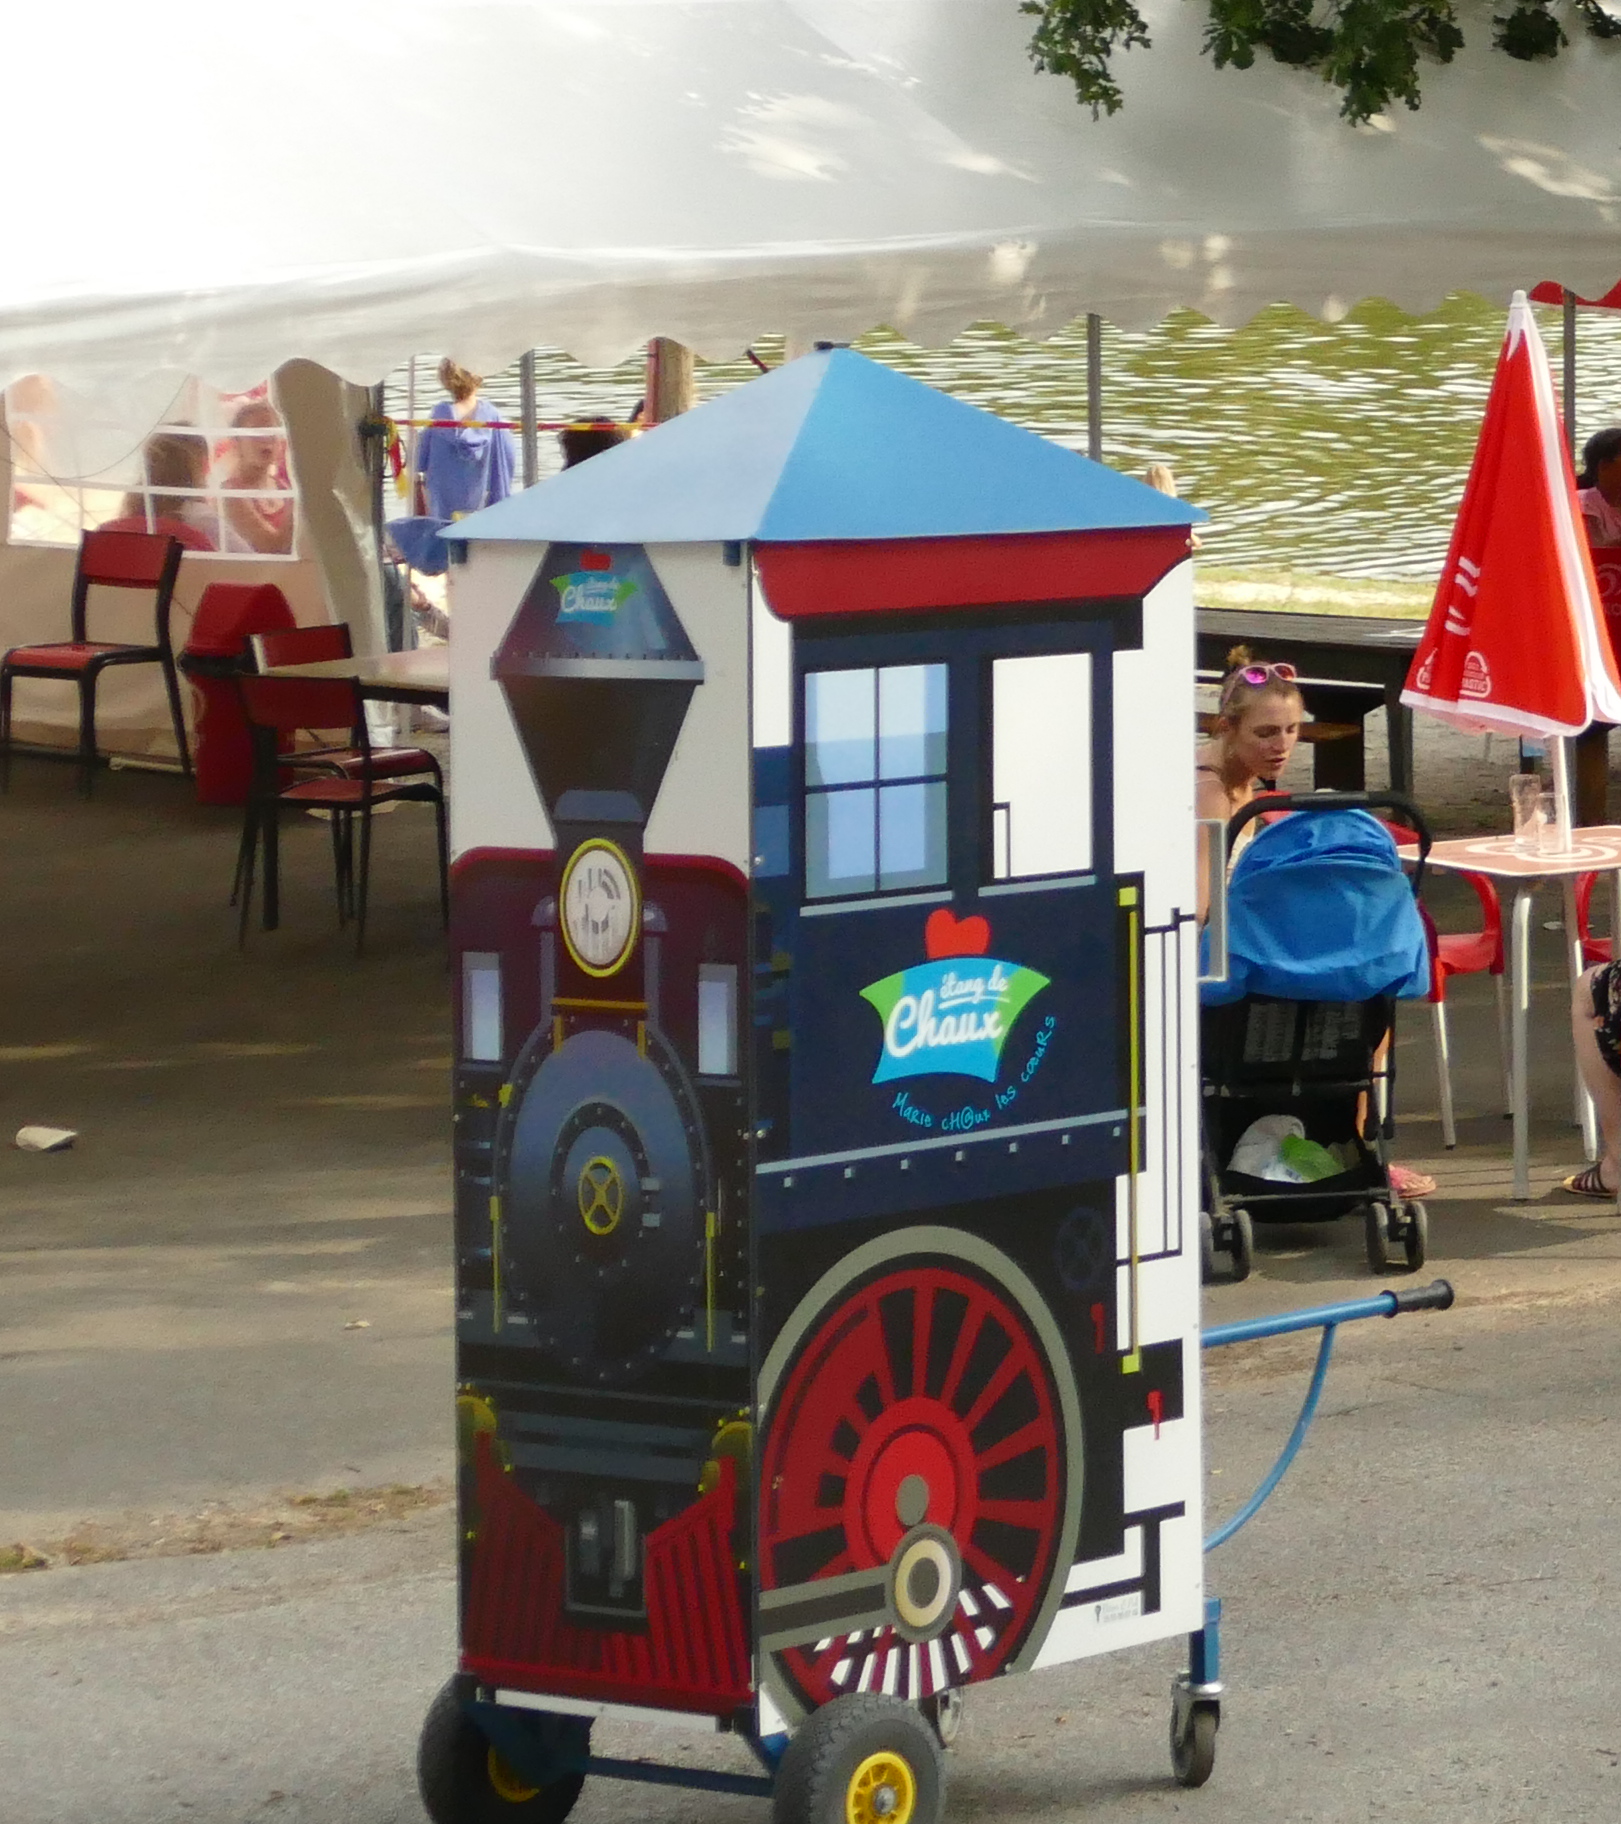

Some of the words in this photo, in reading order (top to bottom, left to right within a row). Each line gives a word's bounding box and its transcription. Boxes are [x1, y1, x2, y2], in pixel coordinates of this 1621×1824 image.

[561, 584, 618, 614] Chaux
[939, 971, 985, 1003] étang
[988, 963, 1008, 993] de
[885, 989, 1003, 1058] Chaux
